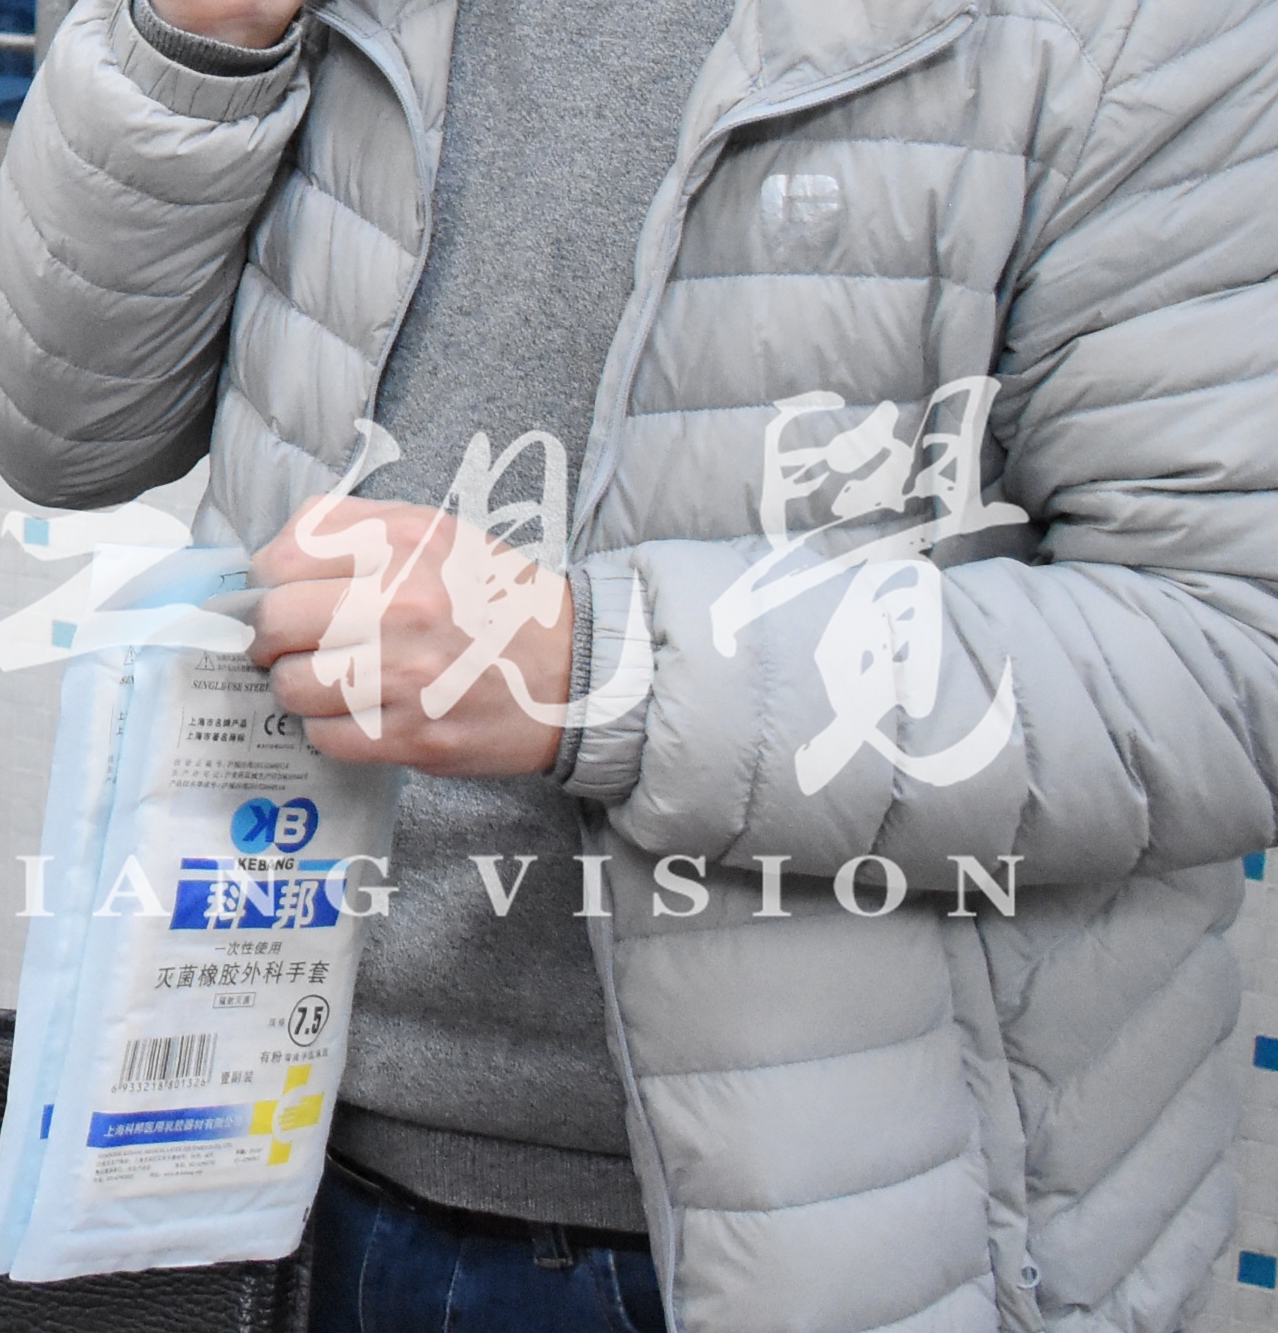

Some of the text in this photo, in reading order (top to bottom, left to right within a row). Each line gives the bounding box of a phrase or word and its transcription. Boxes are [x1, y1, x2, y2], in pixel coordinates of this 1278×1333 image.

[238, 857, 295, 871] KEBANG
[204, 880, 319, 930] 科邦
[215, 941, 282, 956] 一次性使用
[155, 960, 330, 989] 灭菌橡胶外科手套
[294, 1006, 324, 1035] 7.5
